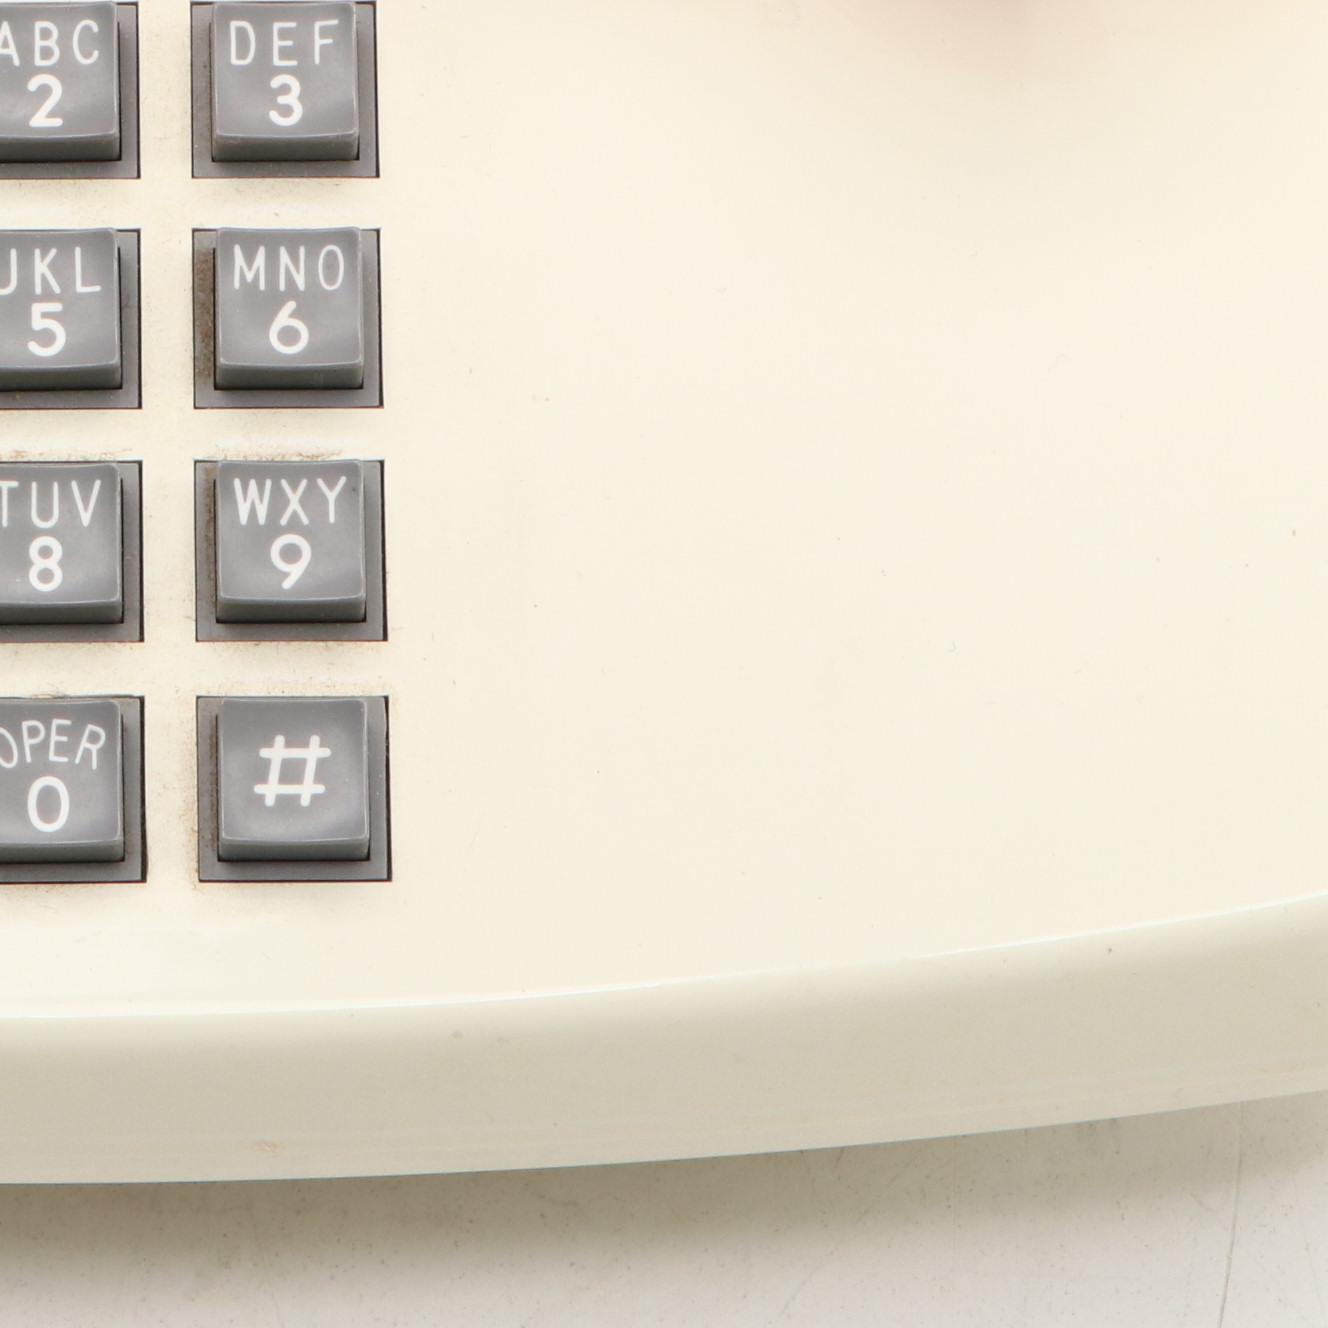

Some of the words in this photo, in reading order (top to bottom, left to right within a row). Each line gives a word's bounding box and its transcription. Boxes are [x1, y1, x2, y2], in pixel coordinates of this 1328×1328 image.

[229, 18, 339, 67] DEF
[26, 73, 64, 128] 2
[268, 73, 304, 127] 3
[233, 243, 346, 292] MNO
[26, 301, 68, 358] 5
[267, 300, 311, 356] 6
[233, 475, 347, 527] WXY
[27, 535, 64, 593] 8
[269, 533, 313, 590] 9
[252, 734, 333, 808] #
[26, 775, 71, 834] 0
